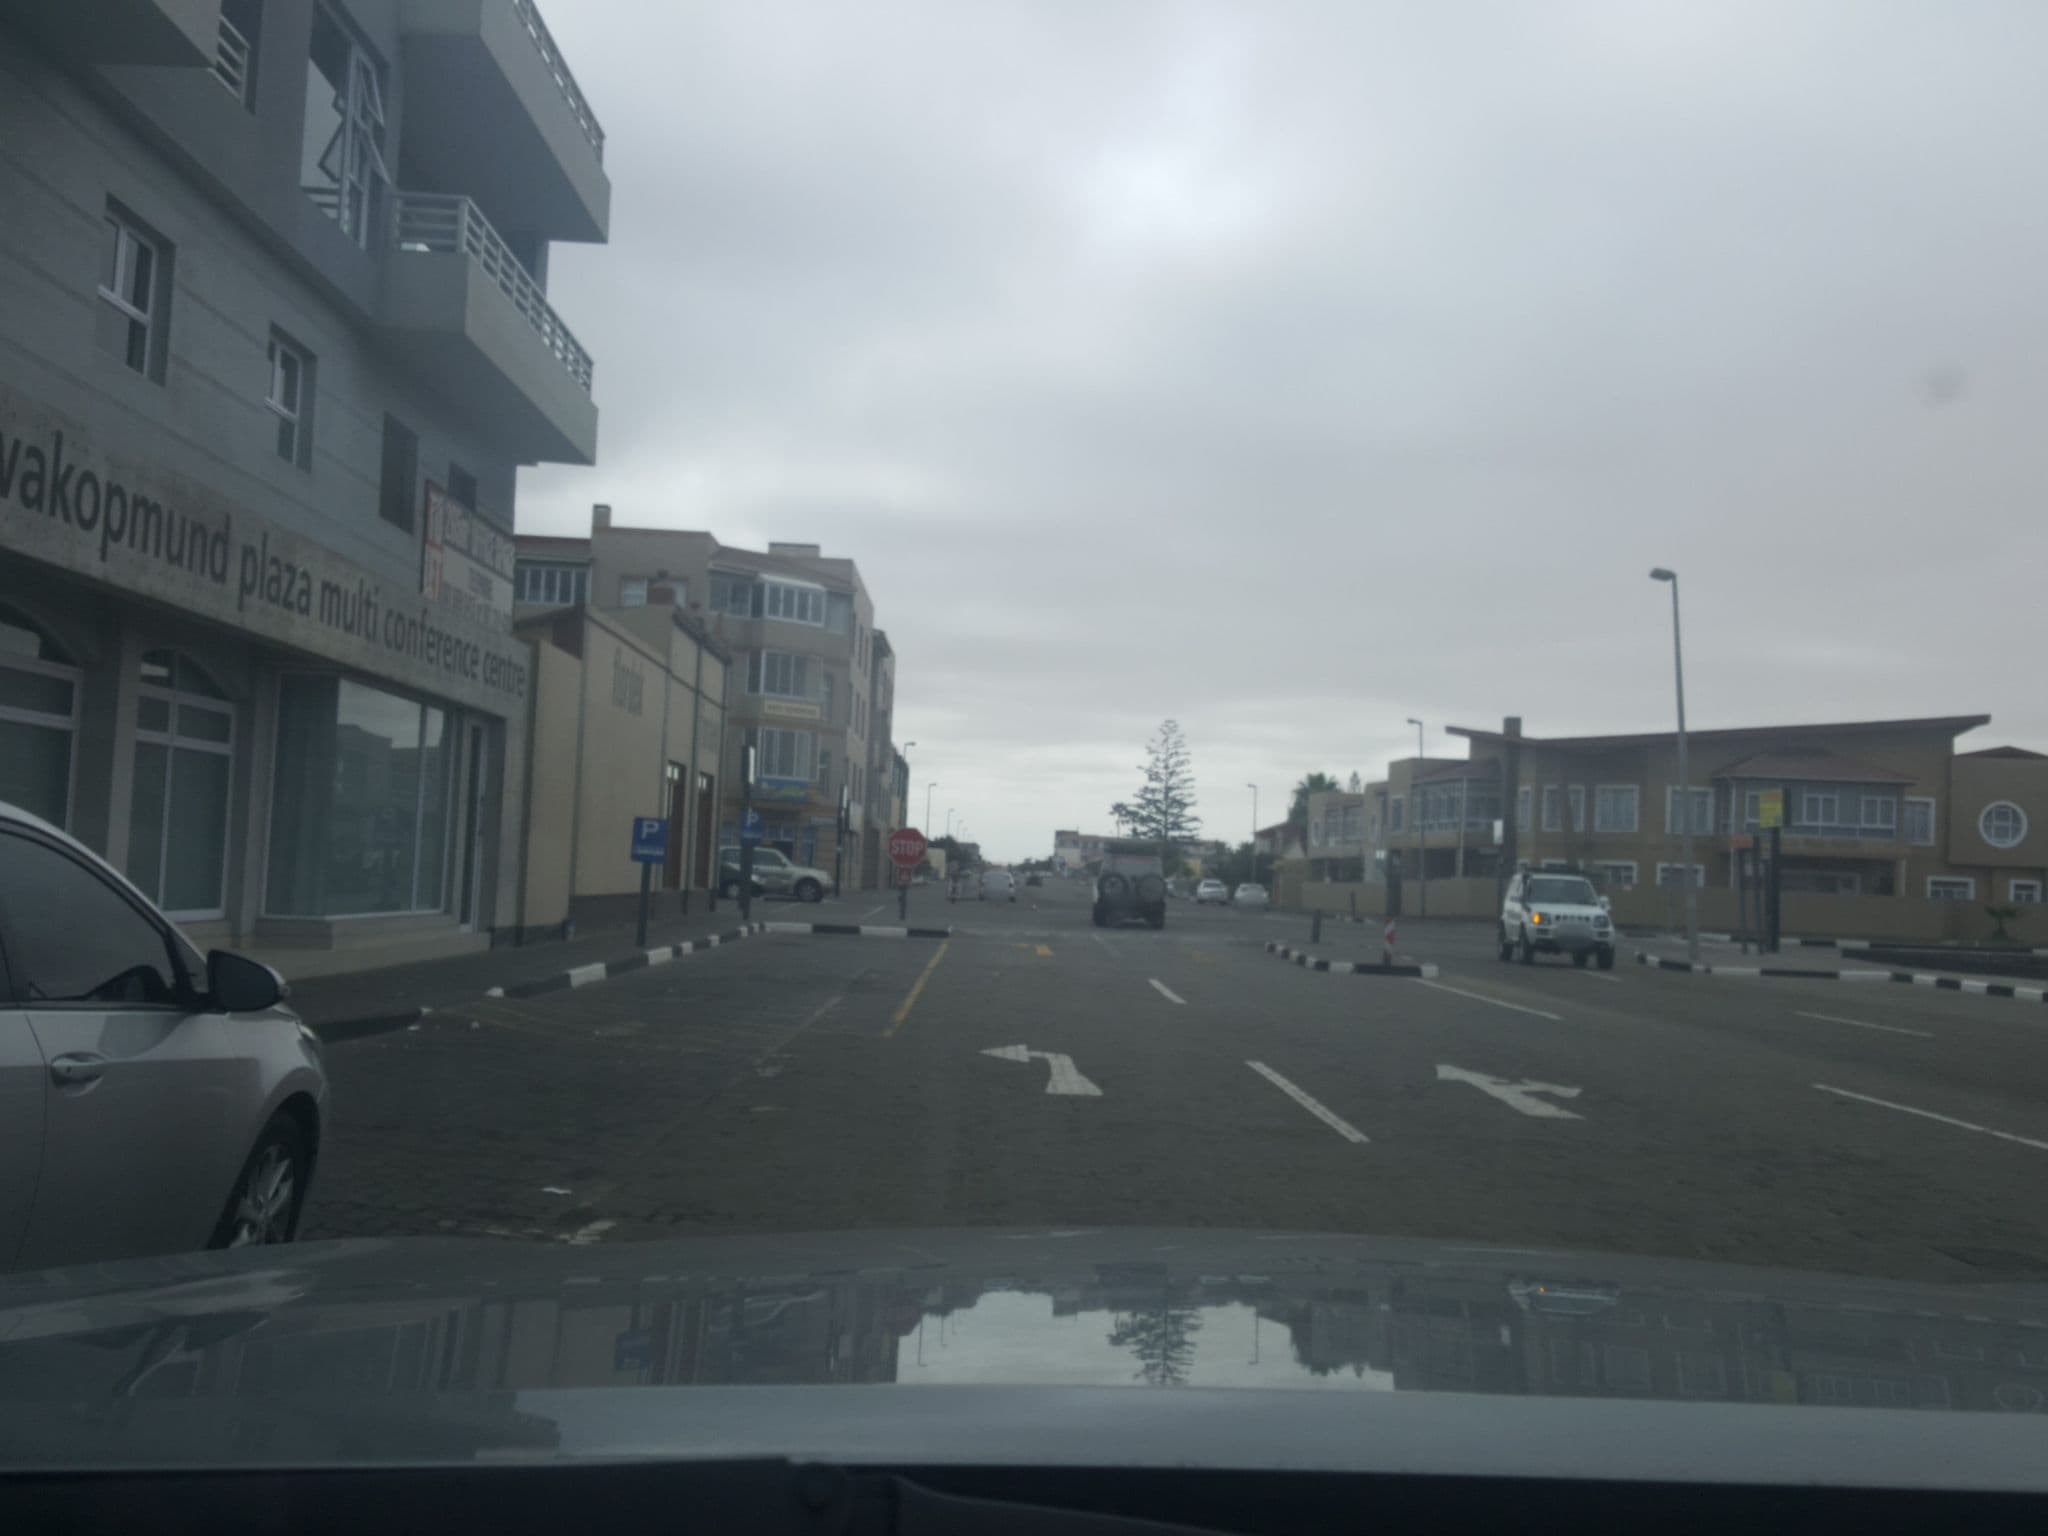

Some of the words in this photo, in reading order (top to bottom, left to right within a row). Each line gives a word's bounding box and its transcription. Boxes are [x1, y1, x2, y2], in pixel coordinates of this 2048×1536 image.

[238, 532, 311, 616] plaza
[320, 578, 379, 643] multi
[384, 608, 479, 681] conference
[483, 650, 526, 697] centre
[641, 819, 659, 840] P
[892, 840, 924, 857] STOP
